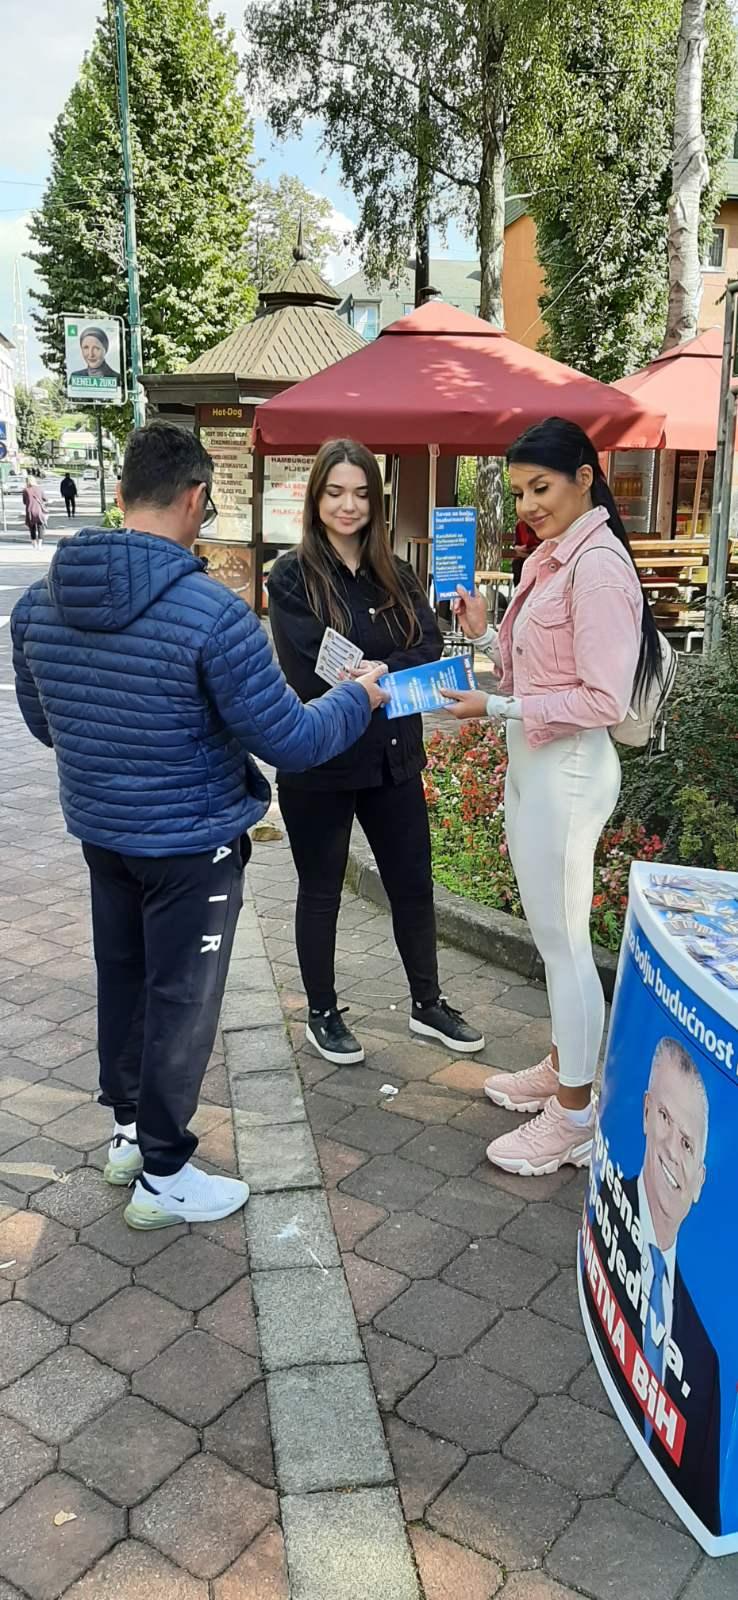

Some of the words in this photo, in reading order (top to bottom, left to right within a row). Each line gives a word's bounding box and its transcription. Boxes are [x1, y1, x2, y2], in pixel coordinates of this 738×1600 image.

[212, 408, 243, 418] Hot-Dog
[634, 935, 655, 988] bolju
[655, 967, 735, 1069] budućnost
[588, 1150, 692, 1399] pobjediva.
[631, 1349, 678, 1450] BiH
